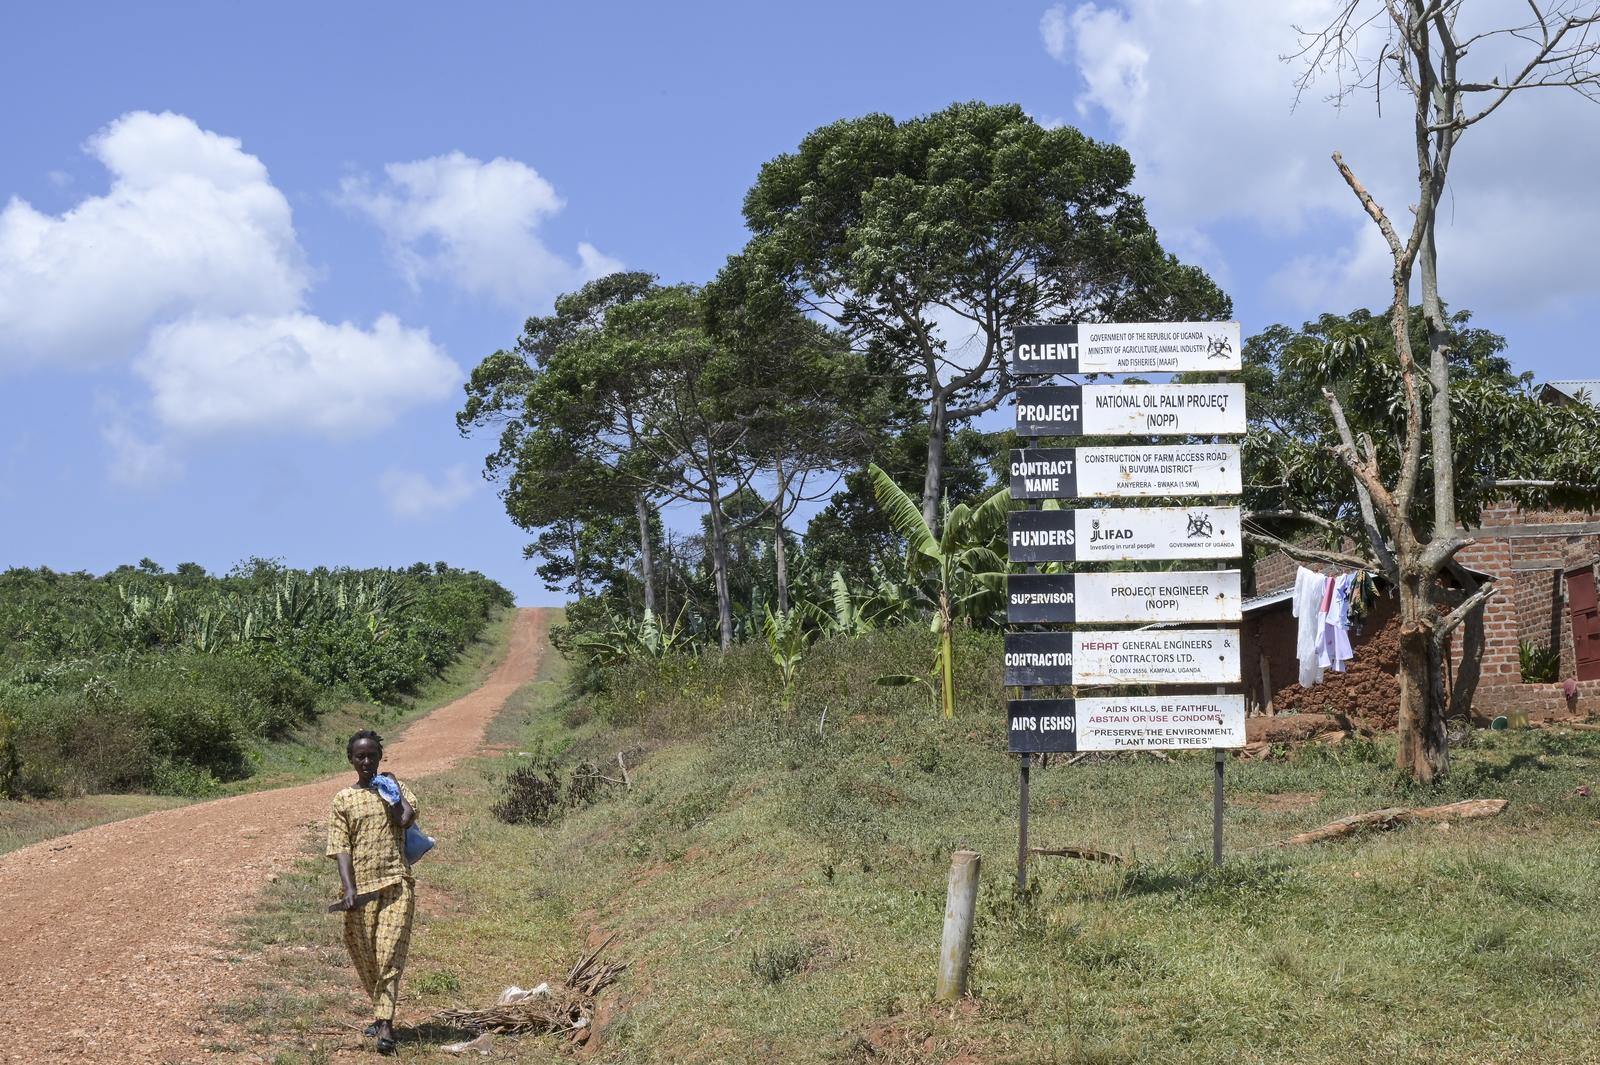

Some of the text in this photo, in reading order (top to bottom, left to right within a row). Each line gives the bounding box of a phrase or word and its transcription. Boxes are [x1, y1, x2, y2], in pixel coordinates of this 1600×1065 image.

[1090, 332, 1203, 342] GOVERNMENT OF THE REPUBLIC OF UGANDA
[1018, 342, 1079, 361] CLIENT
[1088, 346, 1112, 355] MINISTRY
[1114, 346, 1121, 354] OF
[1180, 344, 1206, 353] INDUSTRY
[1118, 358, 1178, 368] AND FISHERIES (MAAIF)
[1096, 394, 1229, 408] NATIONAL OIL PALM PROJECT
[1018, 405, 1079, 422] PROJECT
[1146, 414, 1179, 429] (NOPP)
[1084, 452, 1227, 463] CONSTRUCTION OF FARM ACCESS ROAD
[1012, 461, 1073, 476] CONTRACT
[1128, 465, 1159, 474] BUVUMA
[1160, 465, 1193, 474] DISTRICT
[1025, 478, 1059, 492] NAME
[1012, 530, 1075, 546] FUNDERS
[1105, 530, 1134, 540] IFAD
[1111, 586, 1209, 596] PROJECT ENGINEER
[1011, 592, 1074, 604] SUPERVISOR
[1146, 600, 1179, 610] (NOPP)
[1122, 641, 1162, 650] GENERAL
[1164, 640, 1212, 649] ENGINEERS
[1224, 640, 1231, 648] &
[1005, 653, 1072, 666] CONTRACTOR
[1110, 654, 1195, 663] CONTRACTORS LTD.
[1012, 716, 1076, 733] AIDS (ESHS)
